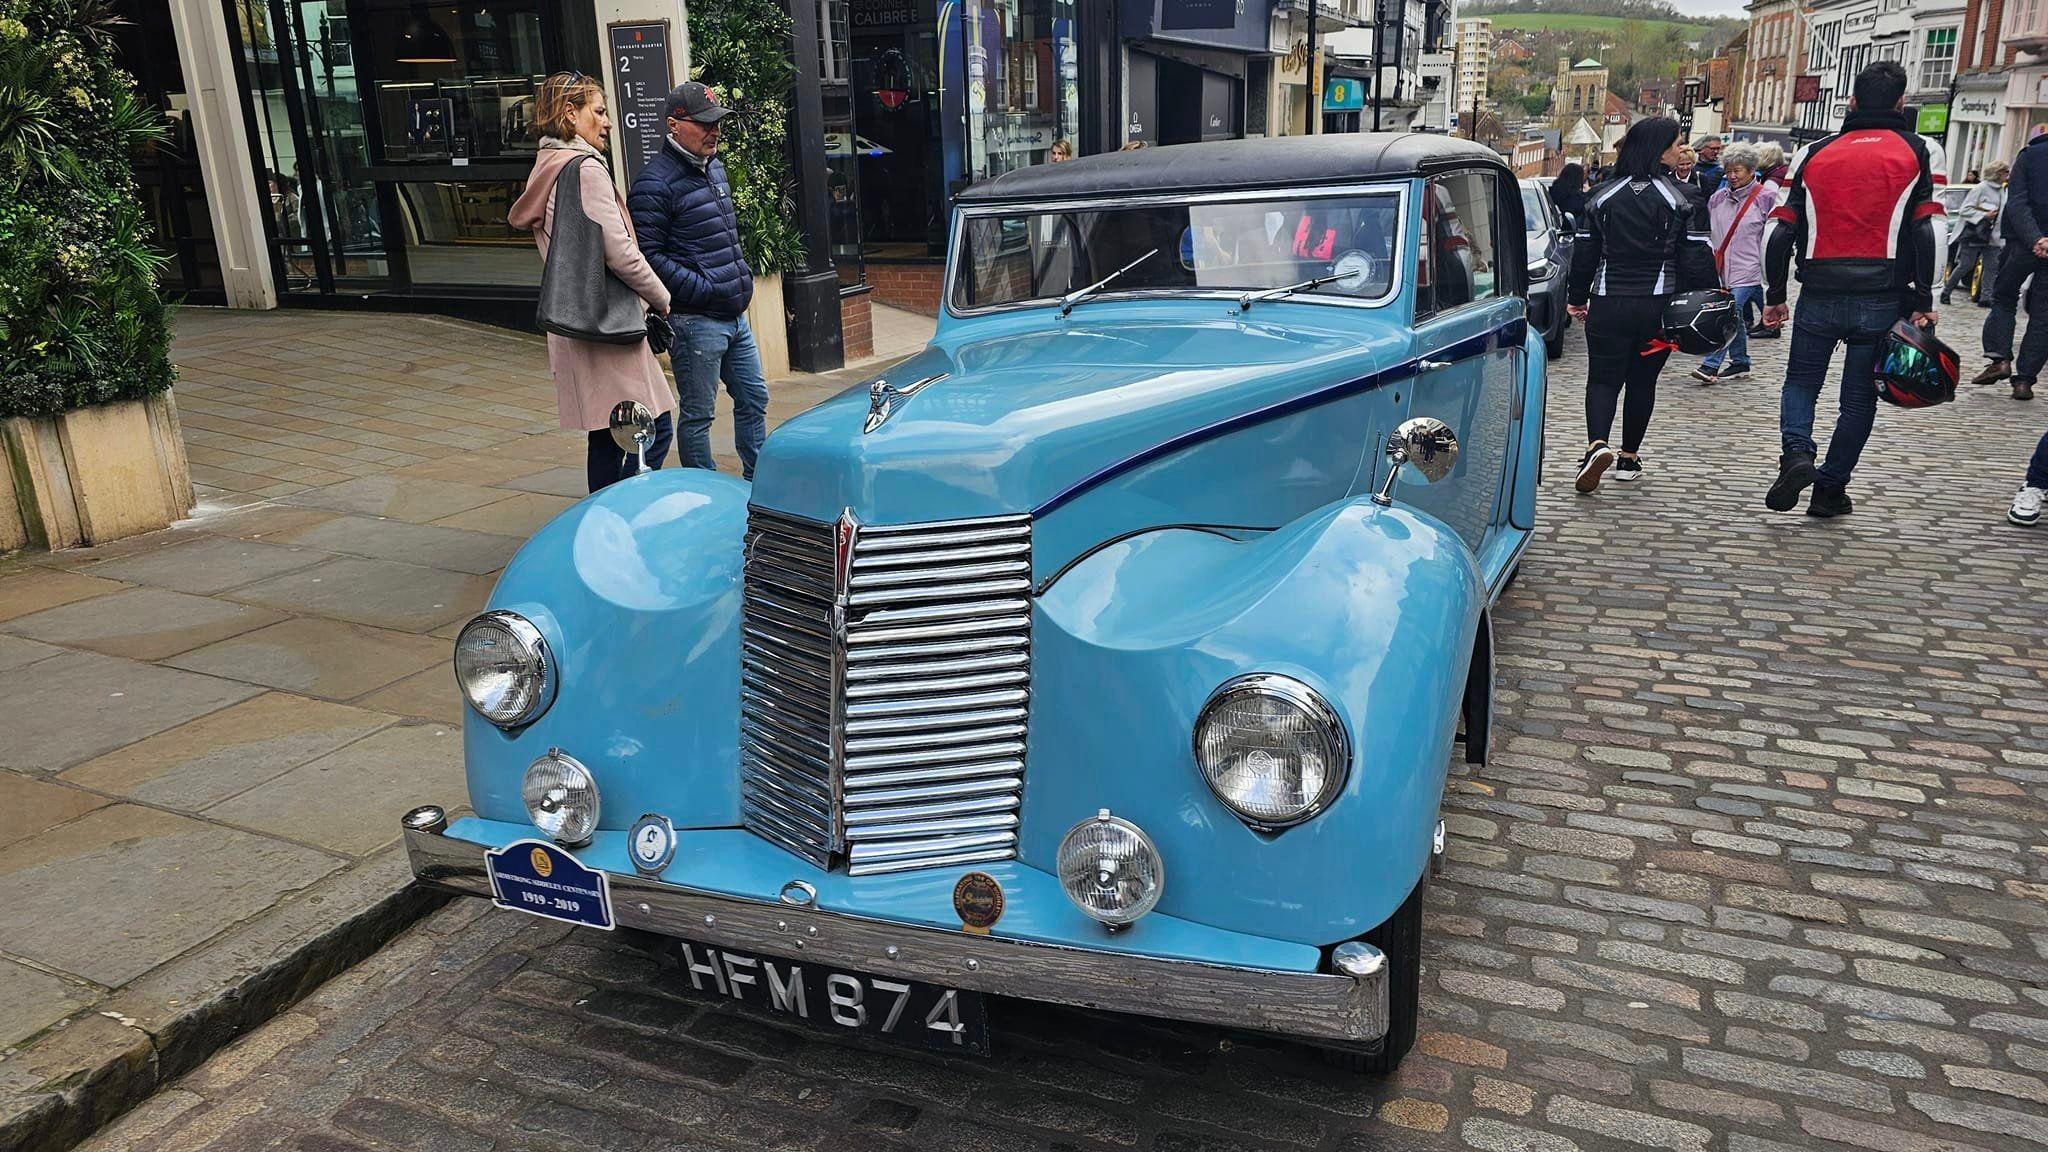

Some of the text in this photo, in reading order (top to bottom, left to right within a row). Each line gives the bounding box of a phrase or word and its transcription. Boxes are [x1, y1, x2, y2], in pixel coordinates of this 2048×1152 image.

[854, 9, 908, 25] CALIBRE
[620, 56, 630, 72] 2
[624, 82, 632, 98] 1
[625, 112, 637, 128] G
[496, 872, 600, 898] ARMSTRONG SIDDELEY CENTENARY
[522, 891, 546, 905] 1919
[554, 898, 580, 912] 2019
[681, 942, 966, 1046] HFM 874
